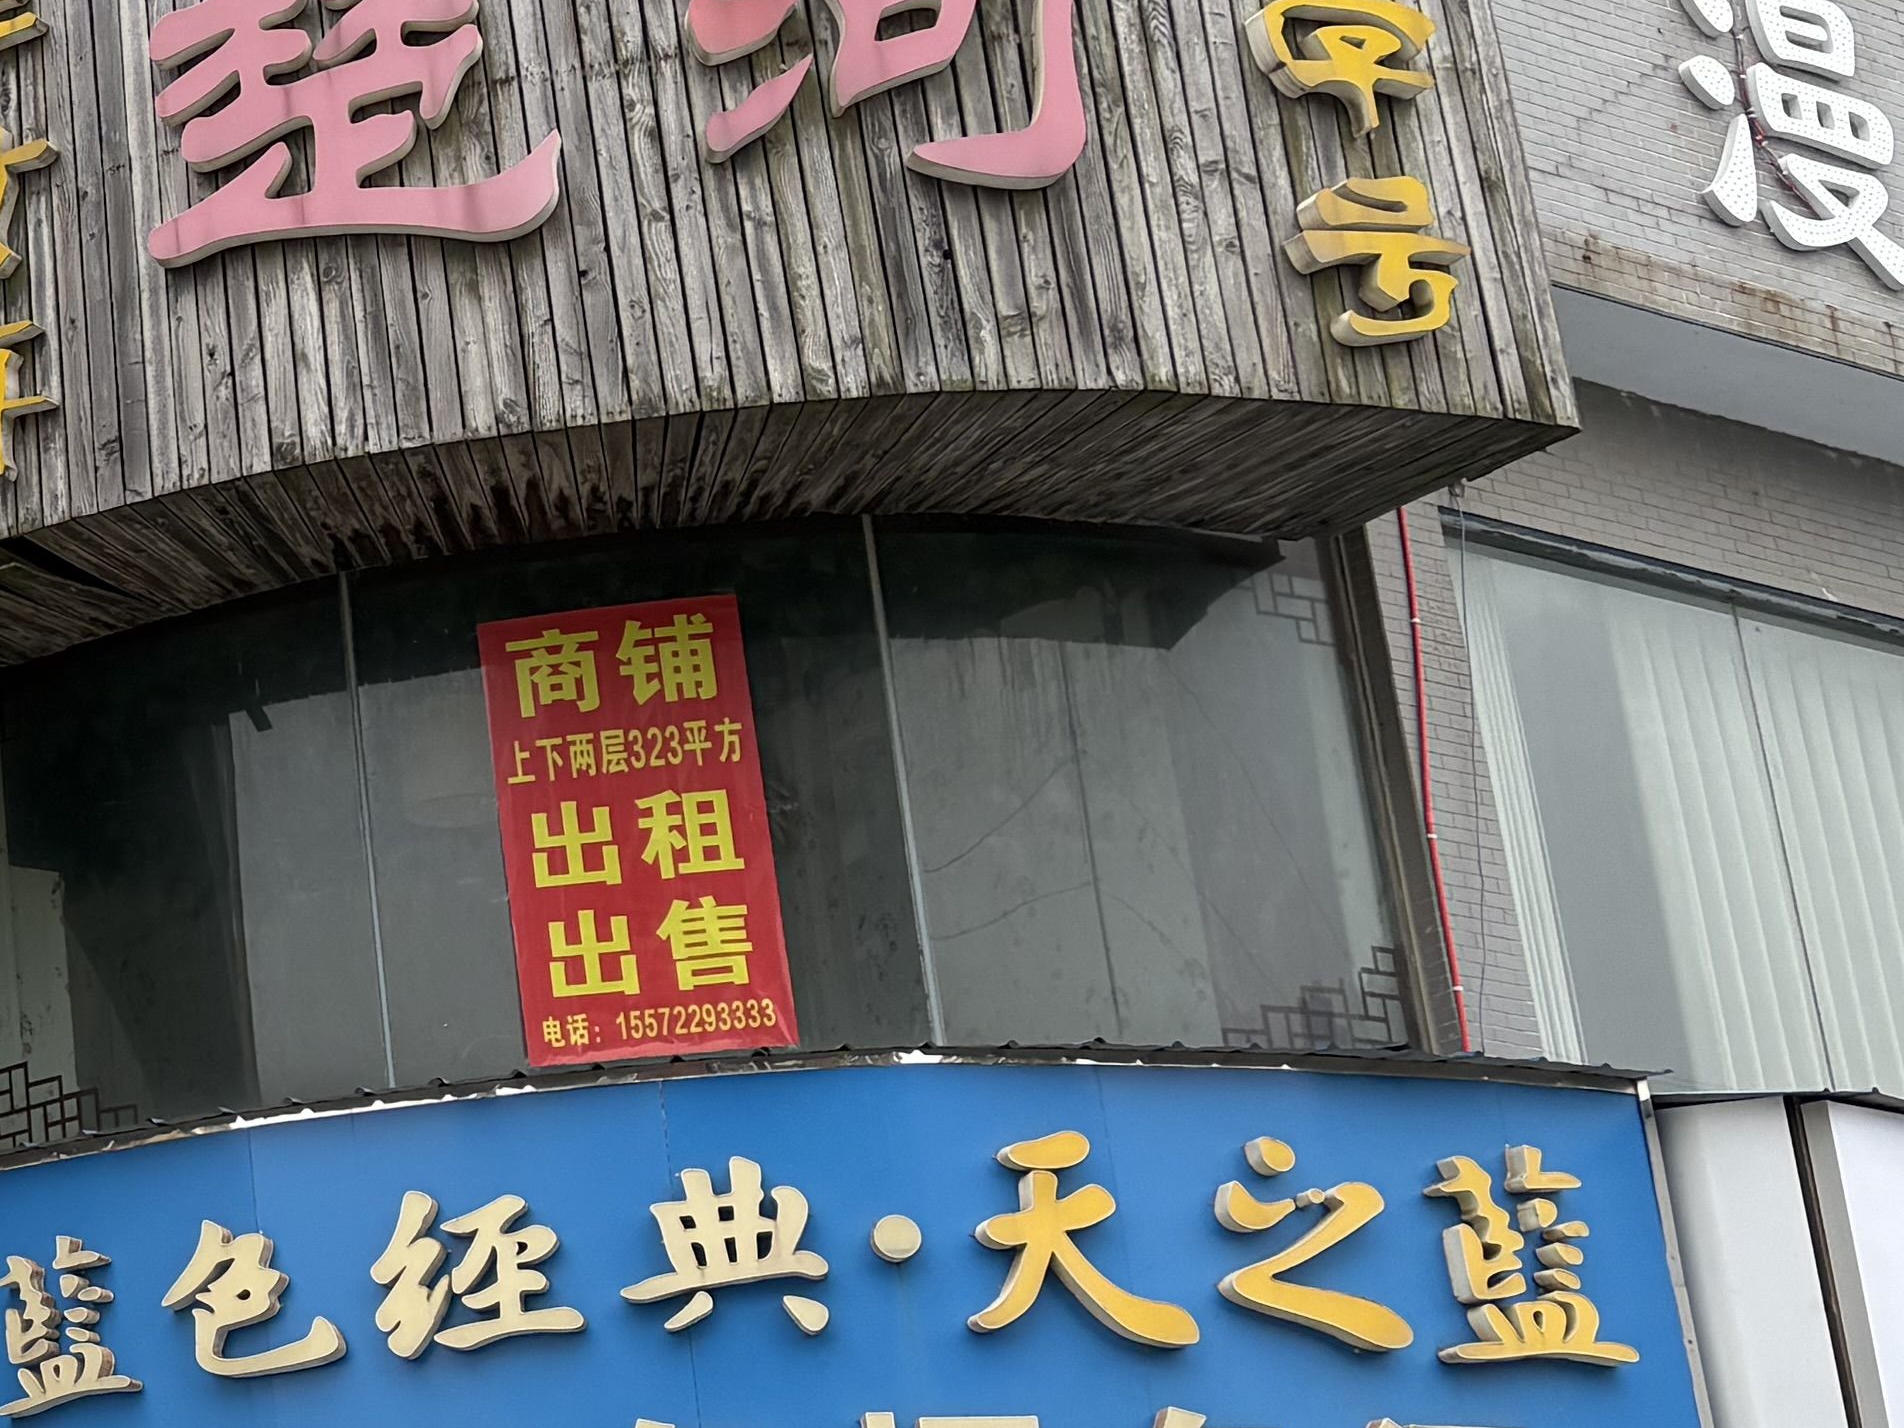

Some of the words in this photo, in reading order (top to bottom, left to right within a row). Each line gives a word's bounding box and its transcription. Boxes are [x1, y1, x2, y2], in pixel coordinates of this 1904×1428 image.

[505, 613, 719, 718] 商铺
[507, 717, 743, 784] 上下两层323平方
[531, 789, 745, 888] 出租
[548, 897, 753, 997] 出售
[616, 999, 777, 1040] 15572293333
